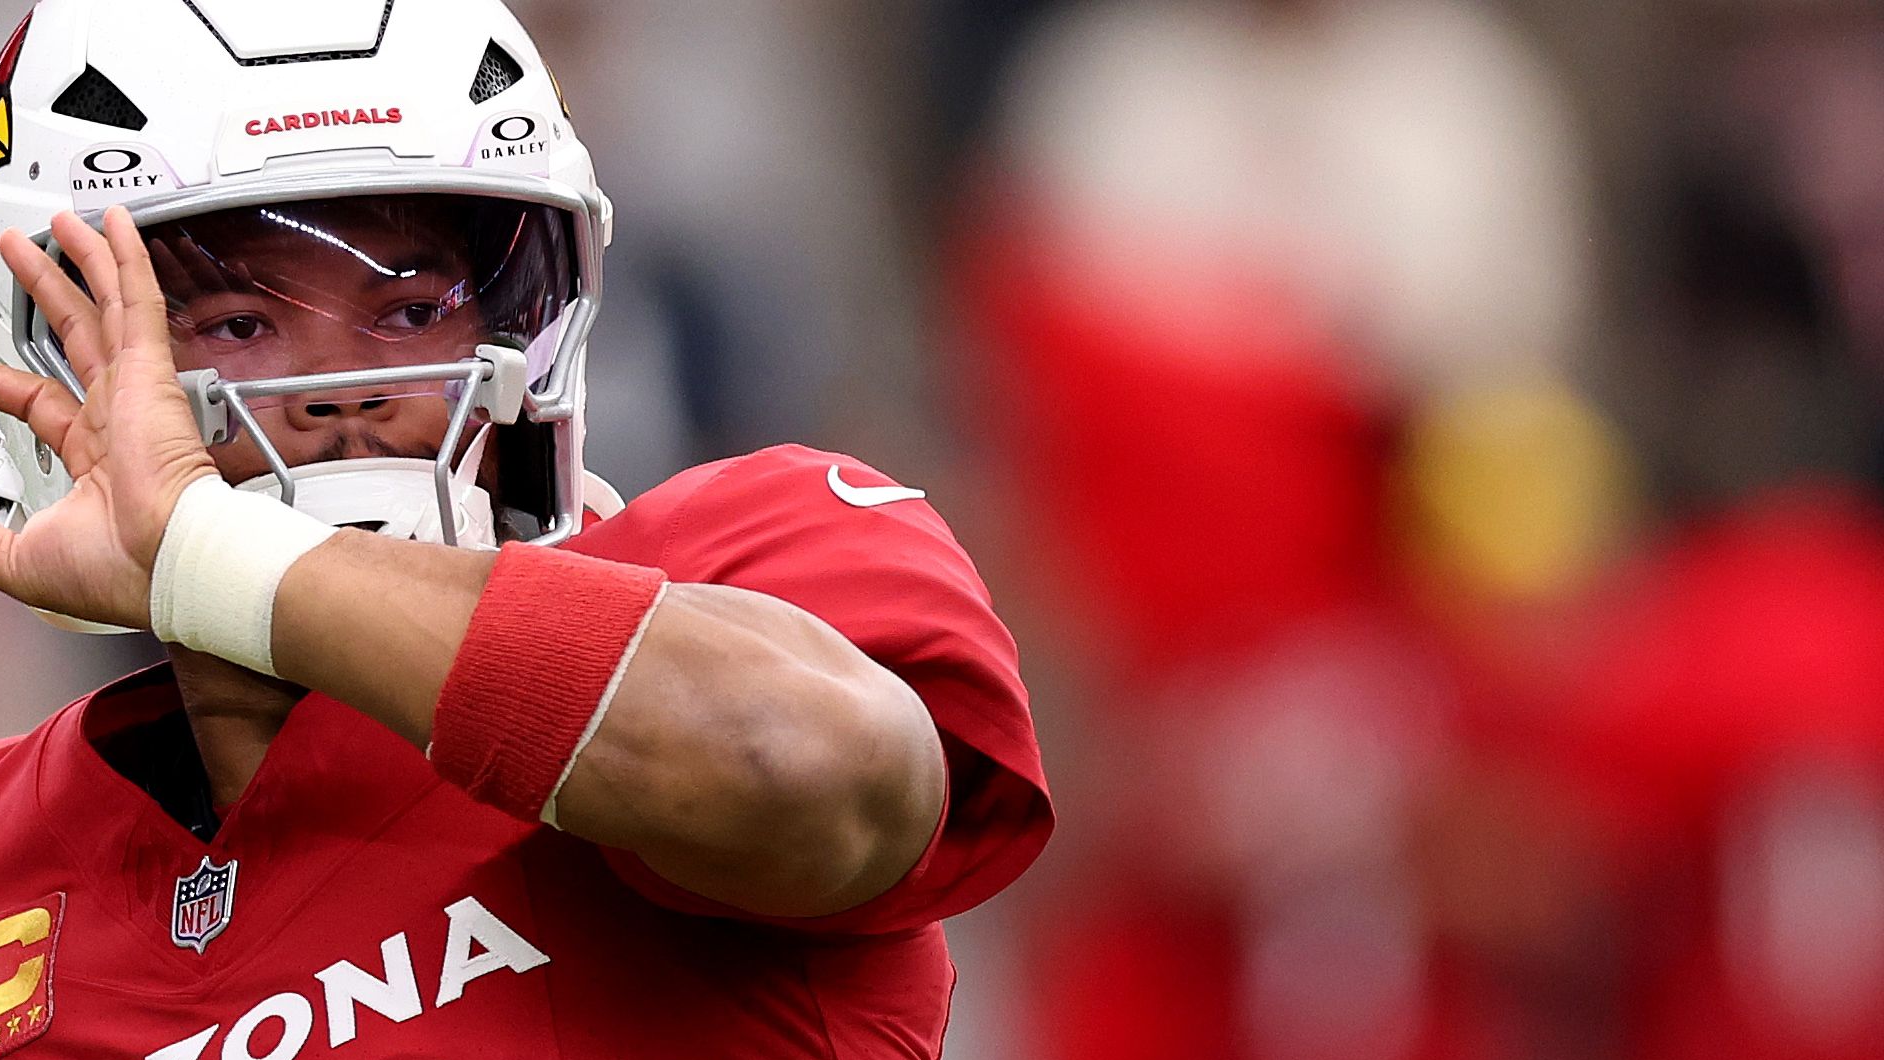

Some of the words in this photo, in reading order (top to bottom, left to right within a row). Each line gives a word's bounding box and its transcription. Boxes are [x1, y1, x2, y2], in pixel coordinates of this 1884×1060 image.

[245, 106, 403, 136] CARDINALS
[480, 141, 546, 160] OAKLEY
[72, 175, 159, 191] OAKLEY
[180, 897, 220, 934] NFL
